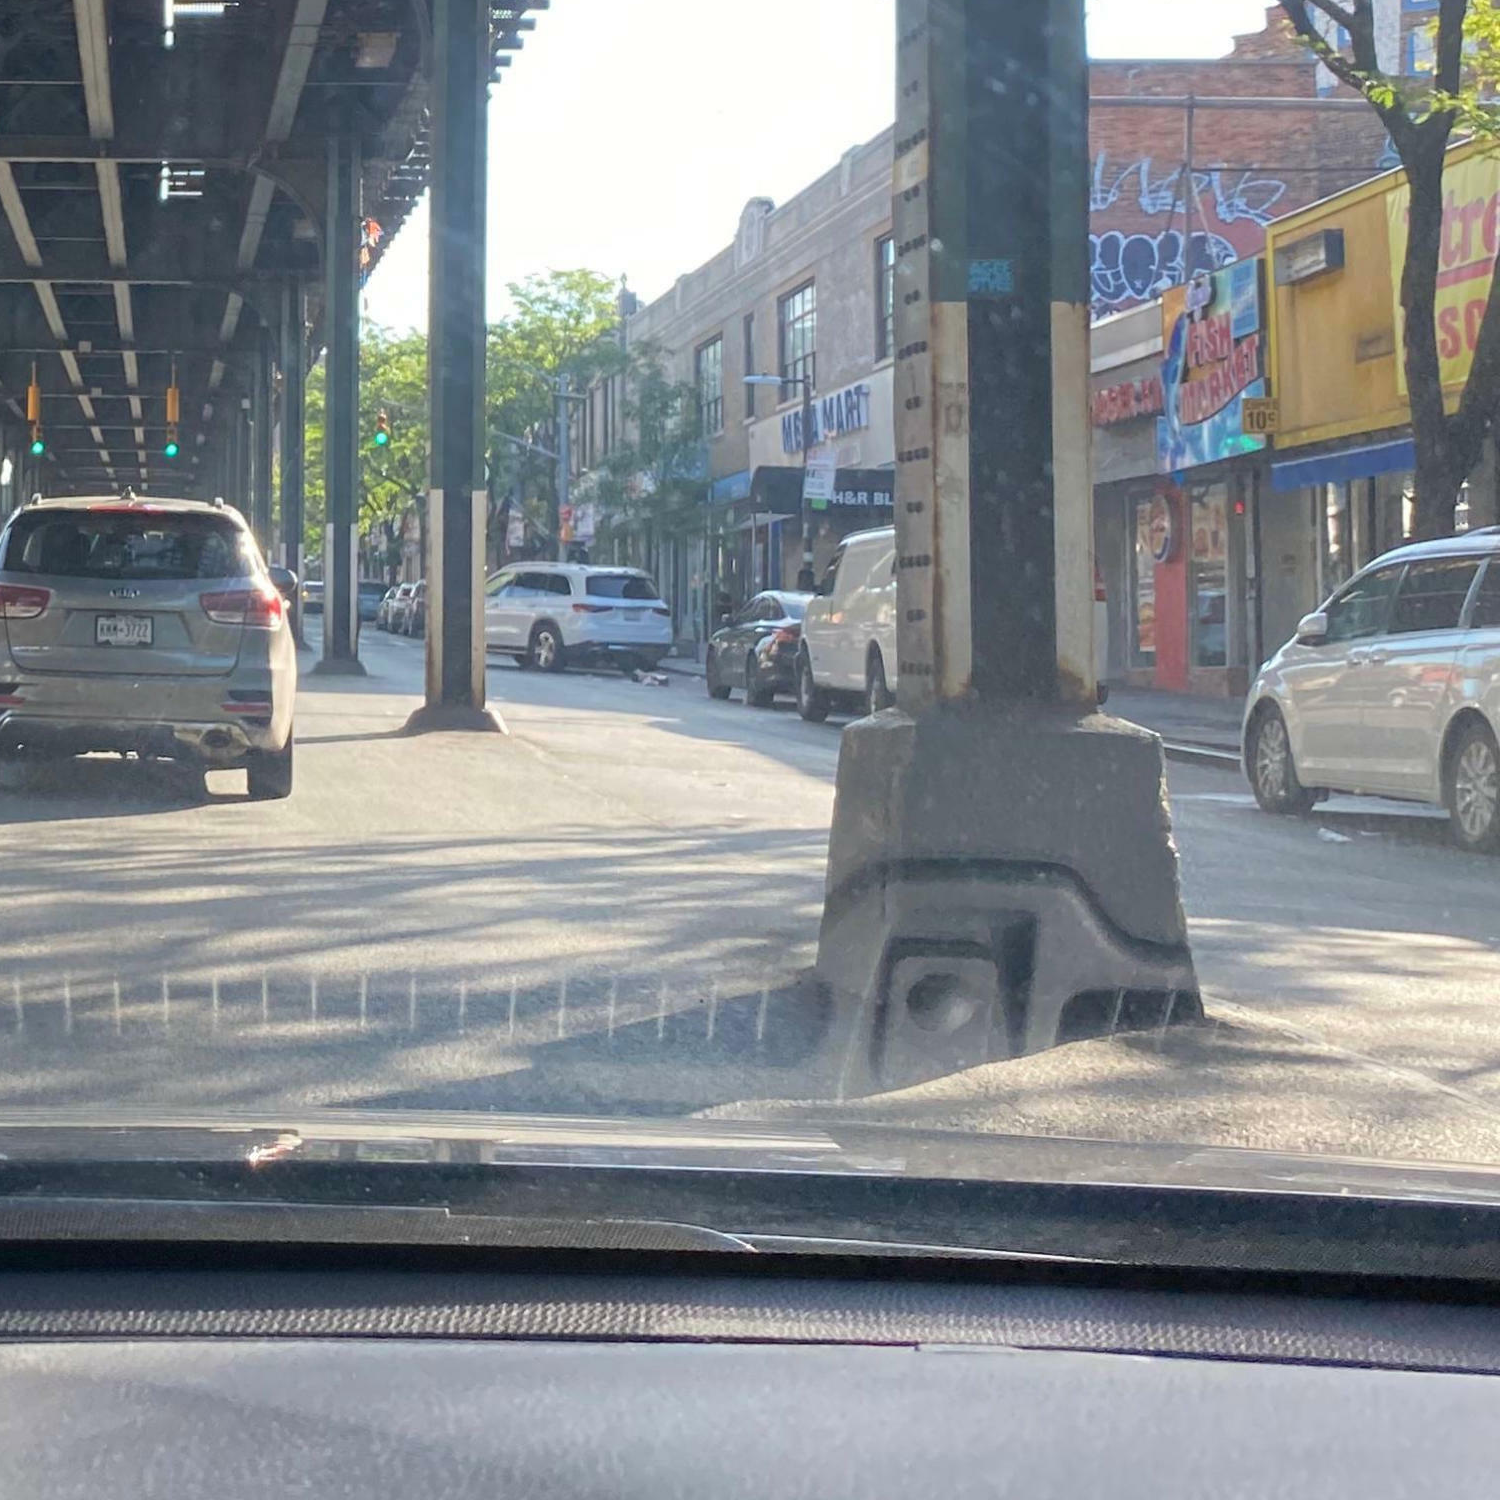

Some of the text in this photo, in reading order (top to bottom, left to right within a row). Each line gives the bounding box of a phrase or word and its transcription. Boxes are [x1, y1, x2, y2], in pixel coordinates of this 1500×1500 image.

[1187, 311, 1232, 369] FISH
[1180, 334, 1259, 426] MARKET
[782, 383, 870, 453] MEA MART
[832, 490, 895, 506] H&R BL
